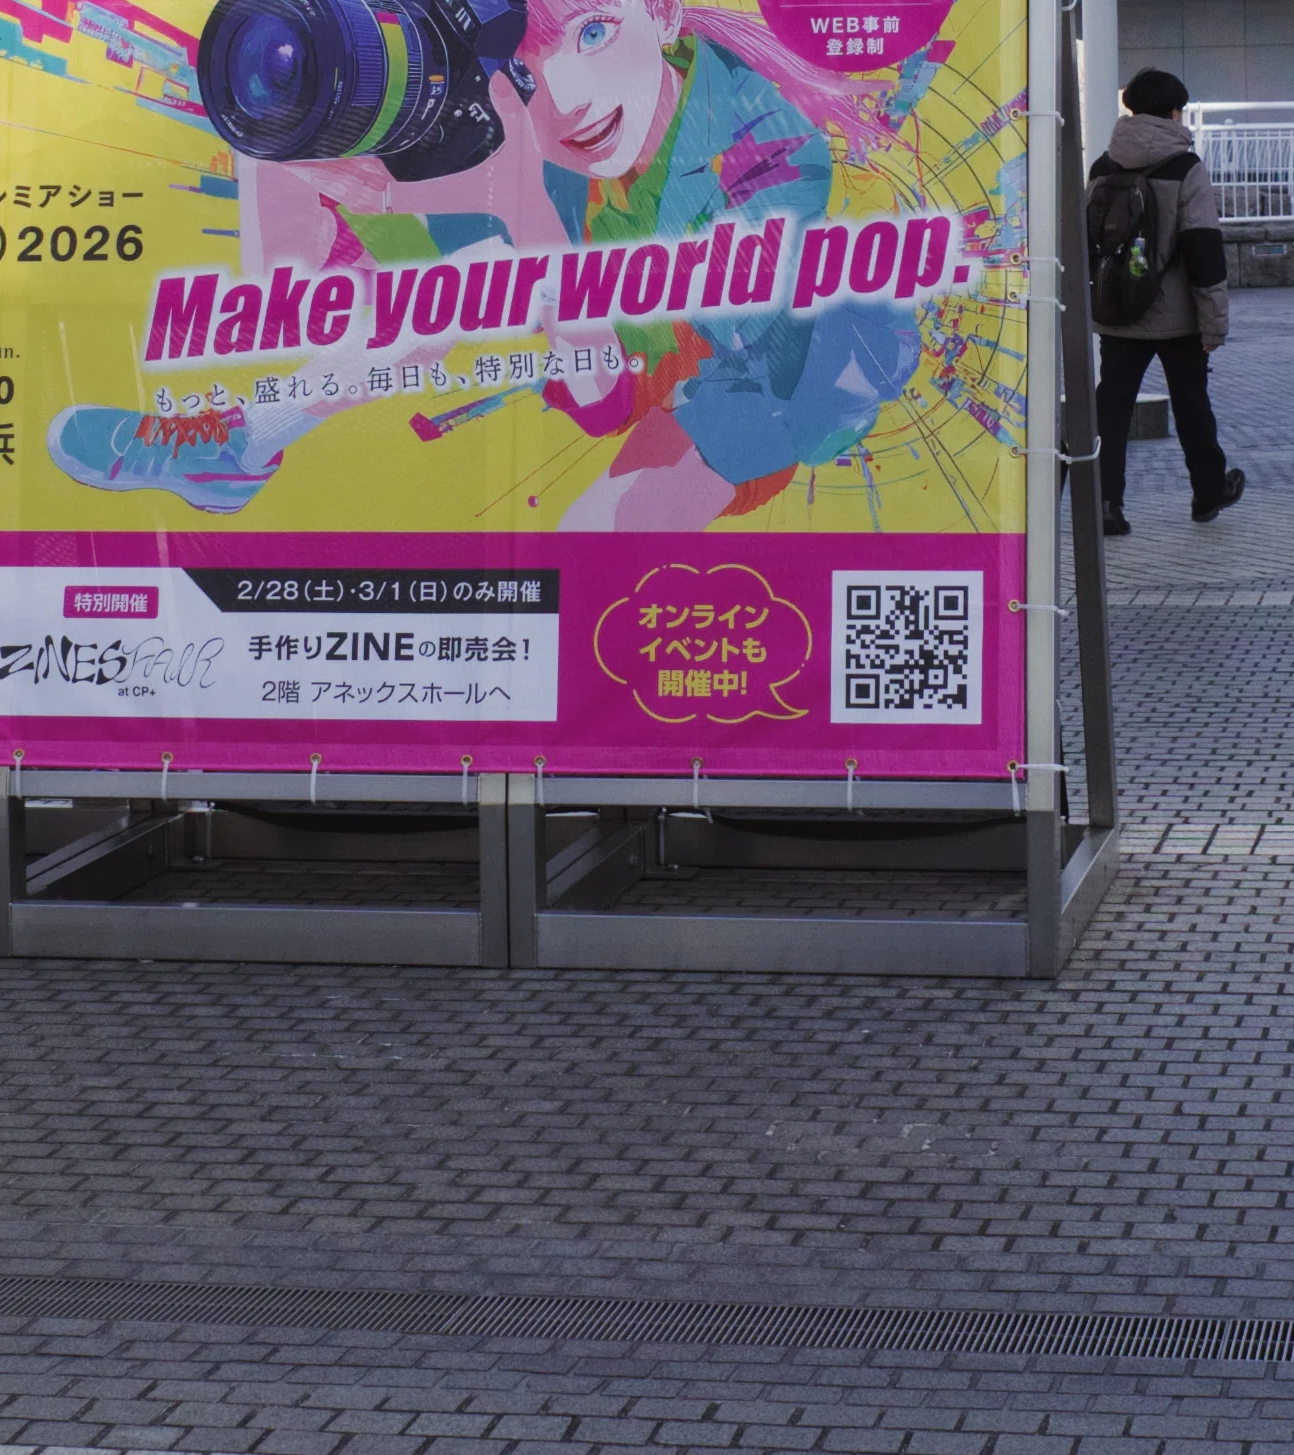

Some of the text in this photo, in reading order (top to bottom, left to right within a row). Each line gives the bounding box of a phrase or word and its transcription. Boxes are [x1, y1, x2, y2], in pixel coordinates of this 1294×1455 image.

[810, 15, 900, 34] WEB事前
[826, 37, 884, 56] 登録制
[145, 215, 971, 362] Make your world pop.
[155, 345, 640, 412] もっと、盛れる。毎日も、特別な日も。
[73, 593, 148, 613] 特別開催
[639, 604, 769, 630] オンライン
[639, 637, 767, 663] イベントも
[118, 686, 156, 697] at CP+
[262, 680, 511, 705] 2階 アネックスホールへ
